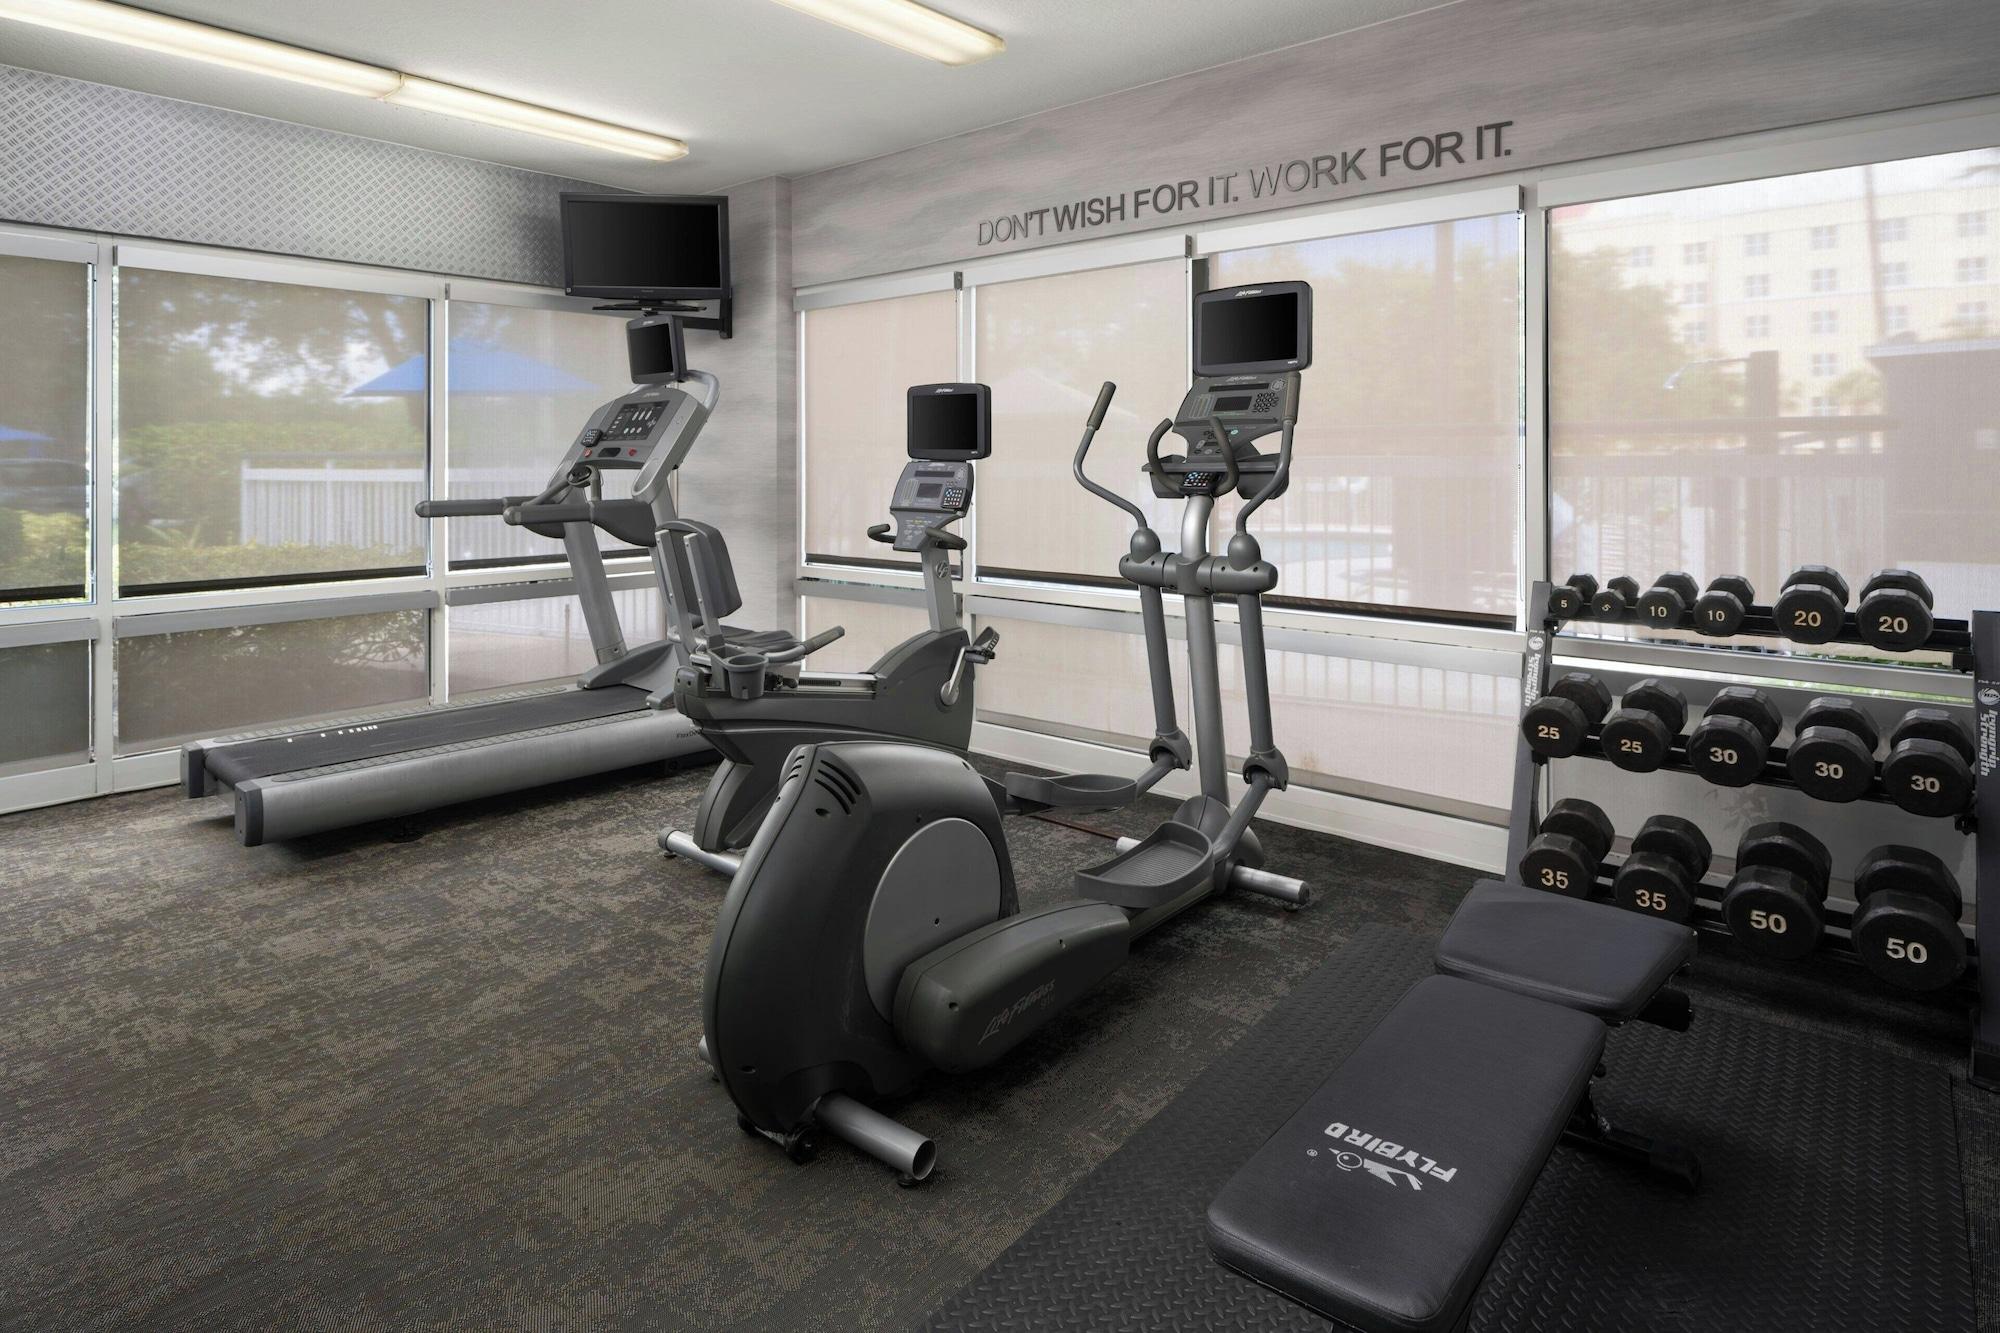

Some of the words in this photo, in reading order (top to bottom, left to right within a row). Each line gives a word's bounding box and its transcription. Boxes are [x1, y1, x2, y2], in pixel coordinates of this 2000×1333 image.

[977, 208, 1049, 246] DON'T
[1053, 193, 1125, 232] WISH
[1134, 179, 1200, 219] FOR
[1208, 172, 1239, 206] IT.
[1250, 147, 1367, 198] WORK
[1380, 131, 1465, 177] FOR
[1476, 120, 1513, 161] IT.
[1560, 599, 1568, 608] 5
[1601, 603, 1612, 612] 5
[1649, 605, 1668, 618] 10
[1707, 609, 1726, 622] 10
[1794, 610, 1822, 627] 20
[1878, 615, 1909, 634] 20
[1537, 724, 1560, 740] 25
[1620, 738, 1643, 754] 25
[1979, 712, 1991, 777] Strength
[1709, 746, 1738, 765] 30
[1814, 761, 1844, 780] 30
[1910, 774, 1940, 794] 30
[1541, 868, 1569, 889] 35
[1635, 889, 1667, 911] 35
[1750, 909, 1787, 934] 50
[1885, 937, 1928, 964] 50
[1324, 1122, 1458, 1183] FLYBIRD
